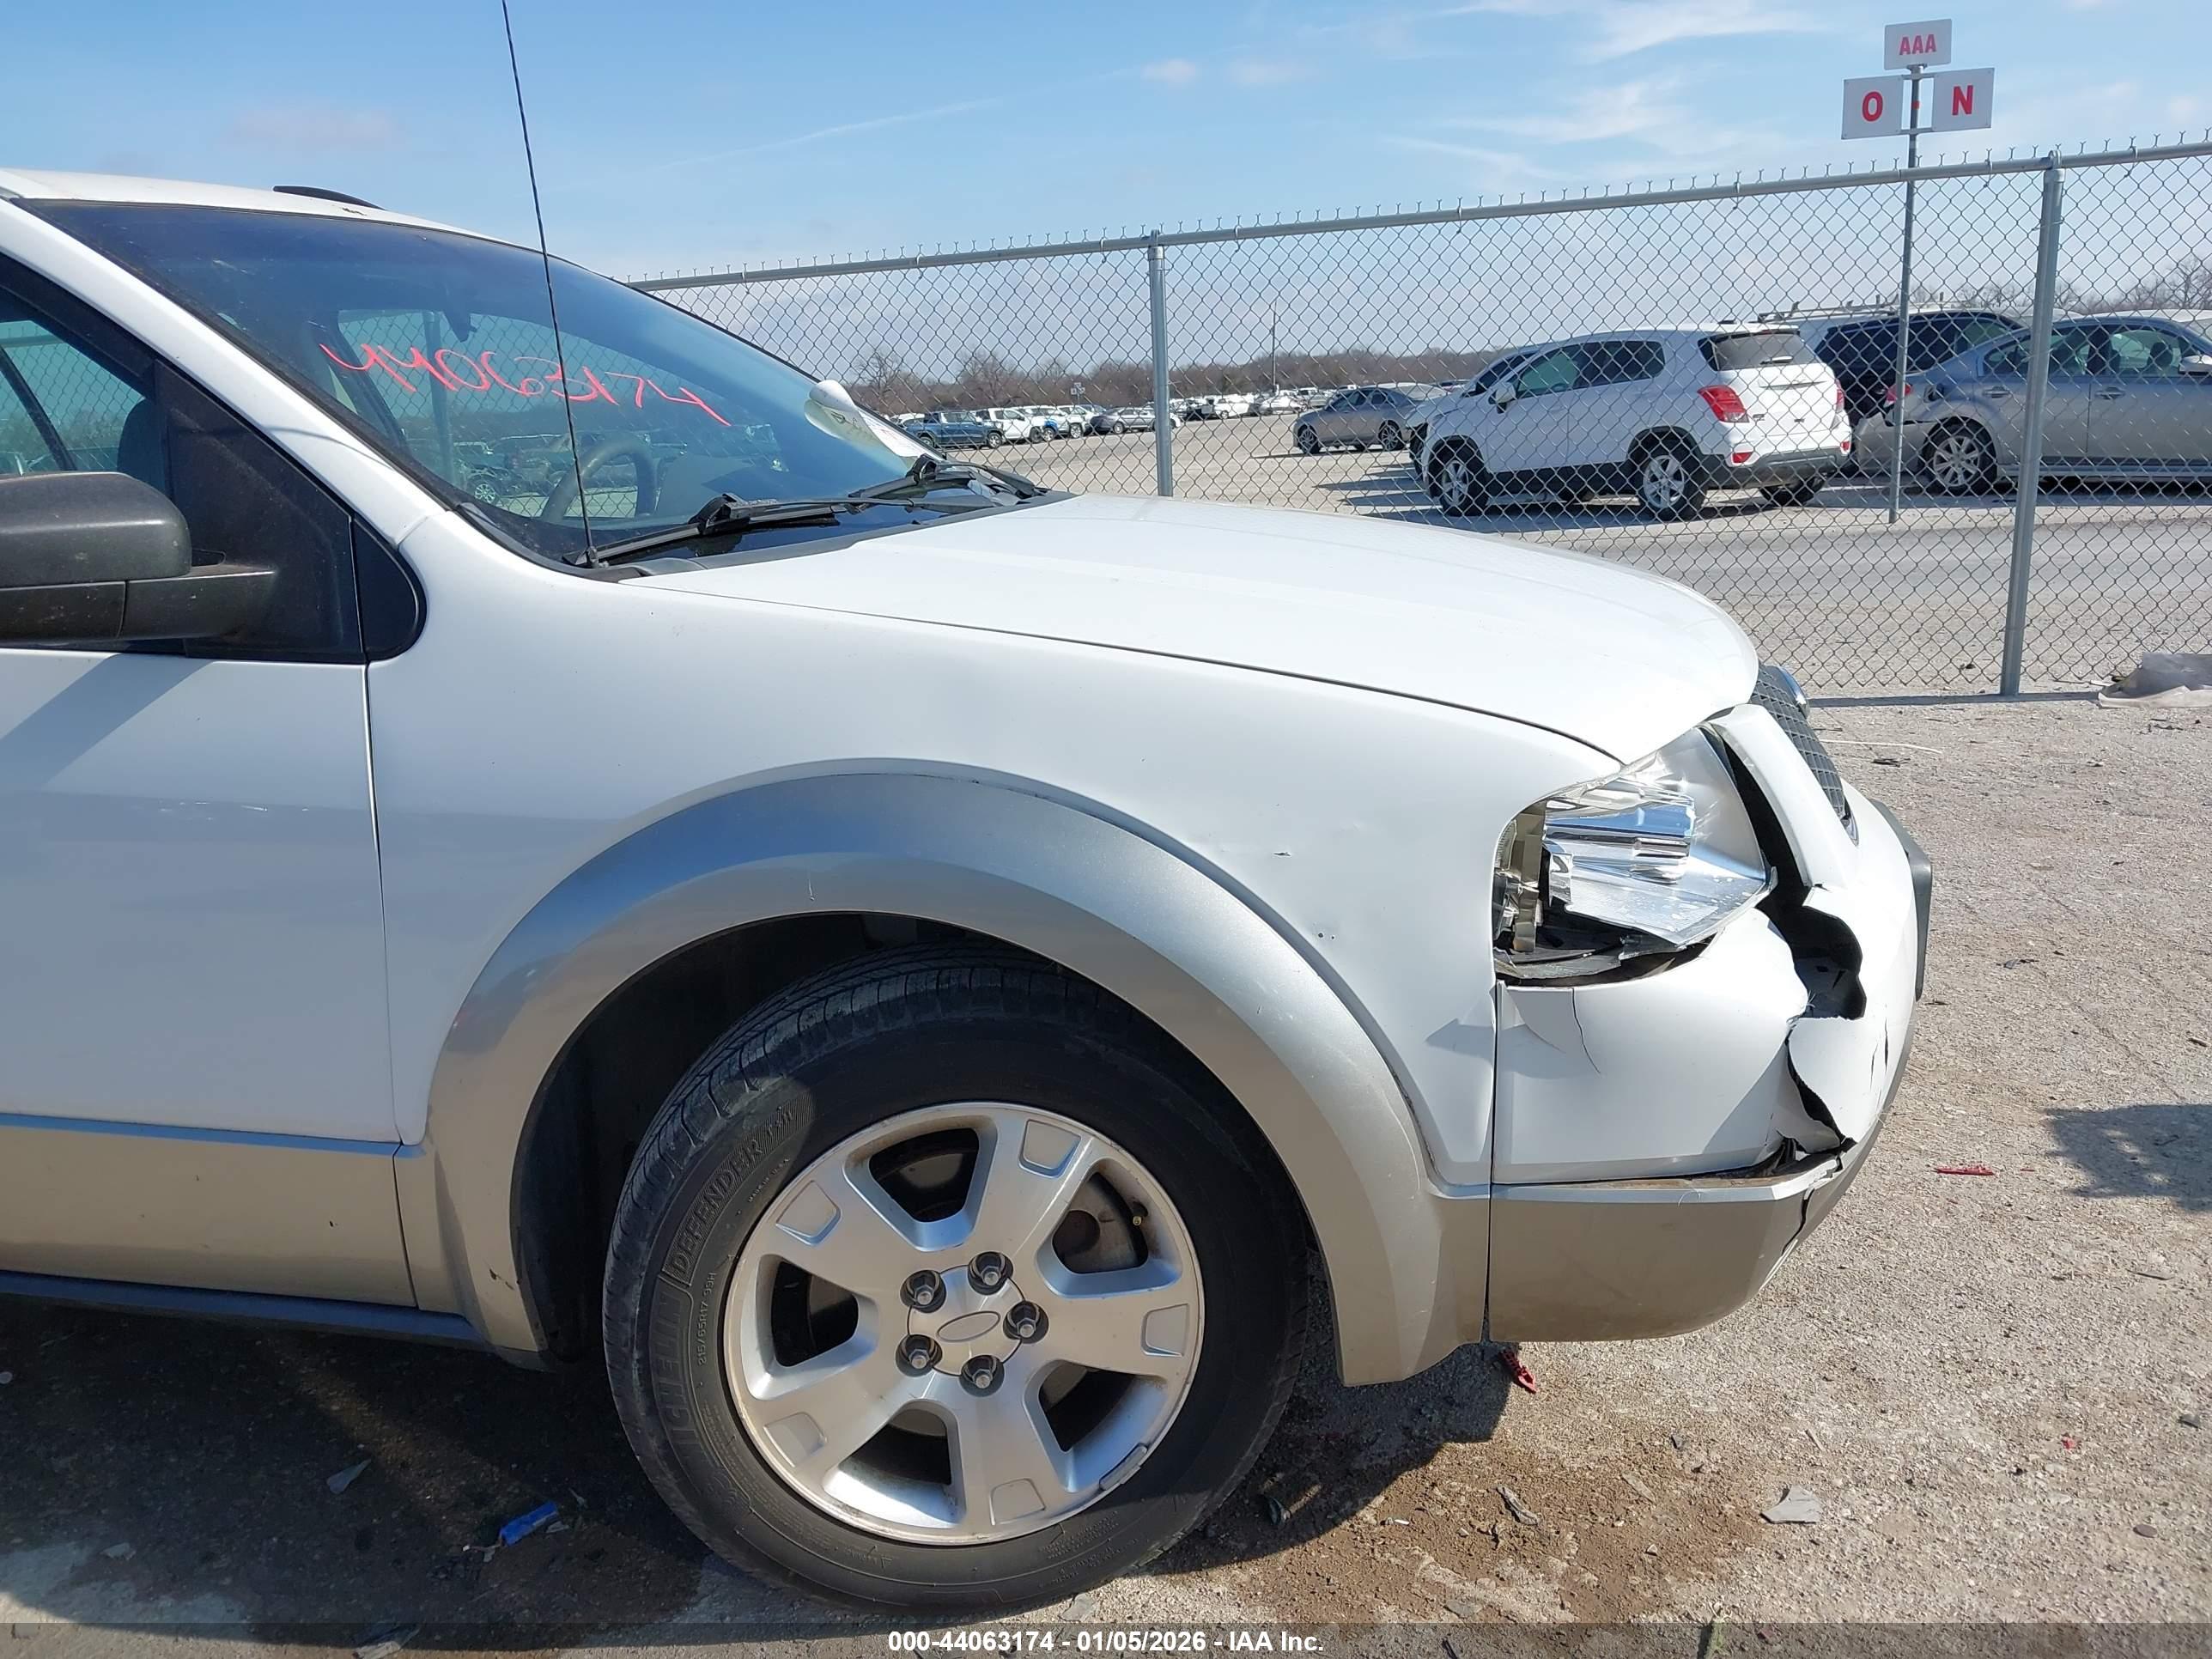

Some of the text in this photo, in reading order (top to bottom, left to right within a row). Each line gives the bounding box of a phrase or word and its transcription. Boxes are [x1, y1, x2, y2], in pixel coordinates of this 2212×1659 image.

[1899, 33, 1937, 56] AAA
[1861, 84, 1974, 122] O N
[319, 343, 732, 428] 44063174
[672, 1139, 763, 1274] DEFENDER
